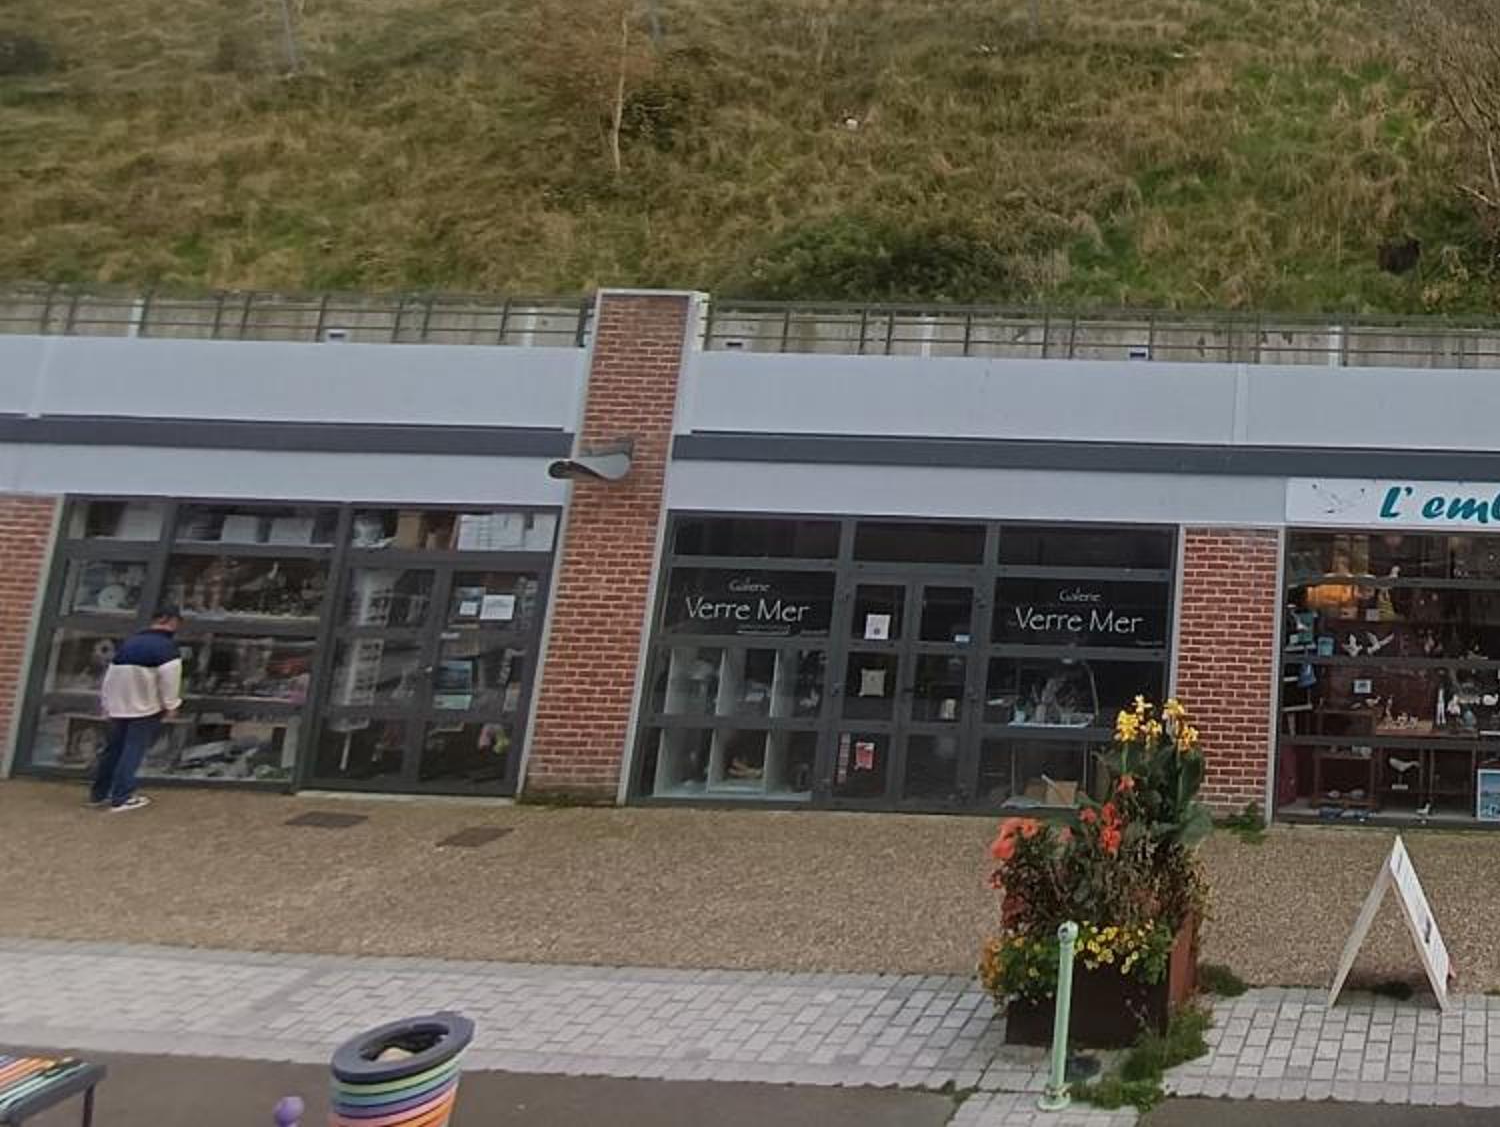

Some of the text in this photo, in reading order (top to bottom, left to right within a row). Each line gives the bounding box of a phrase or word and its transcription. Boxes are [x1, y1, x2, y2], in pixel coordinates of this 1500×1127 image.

[685, 596, 811, 622] Verre Mer
[1015, 606, 1144, 633] Verre Mer
